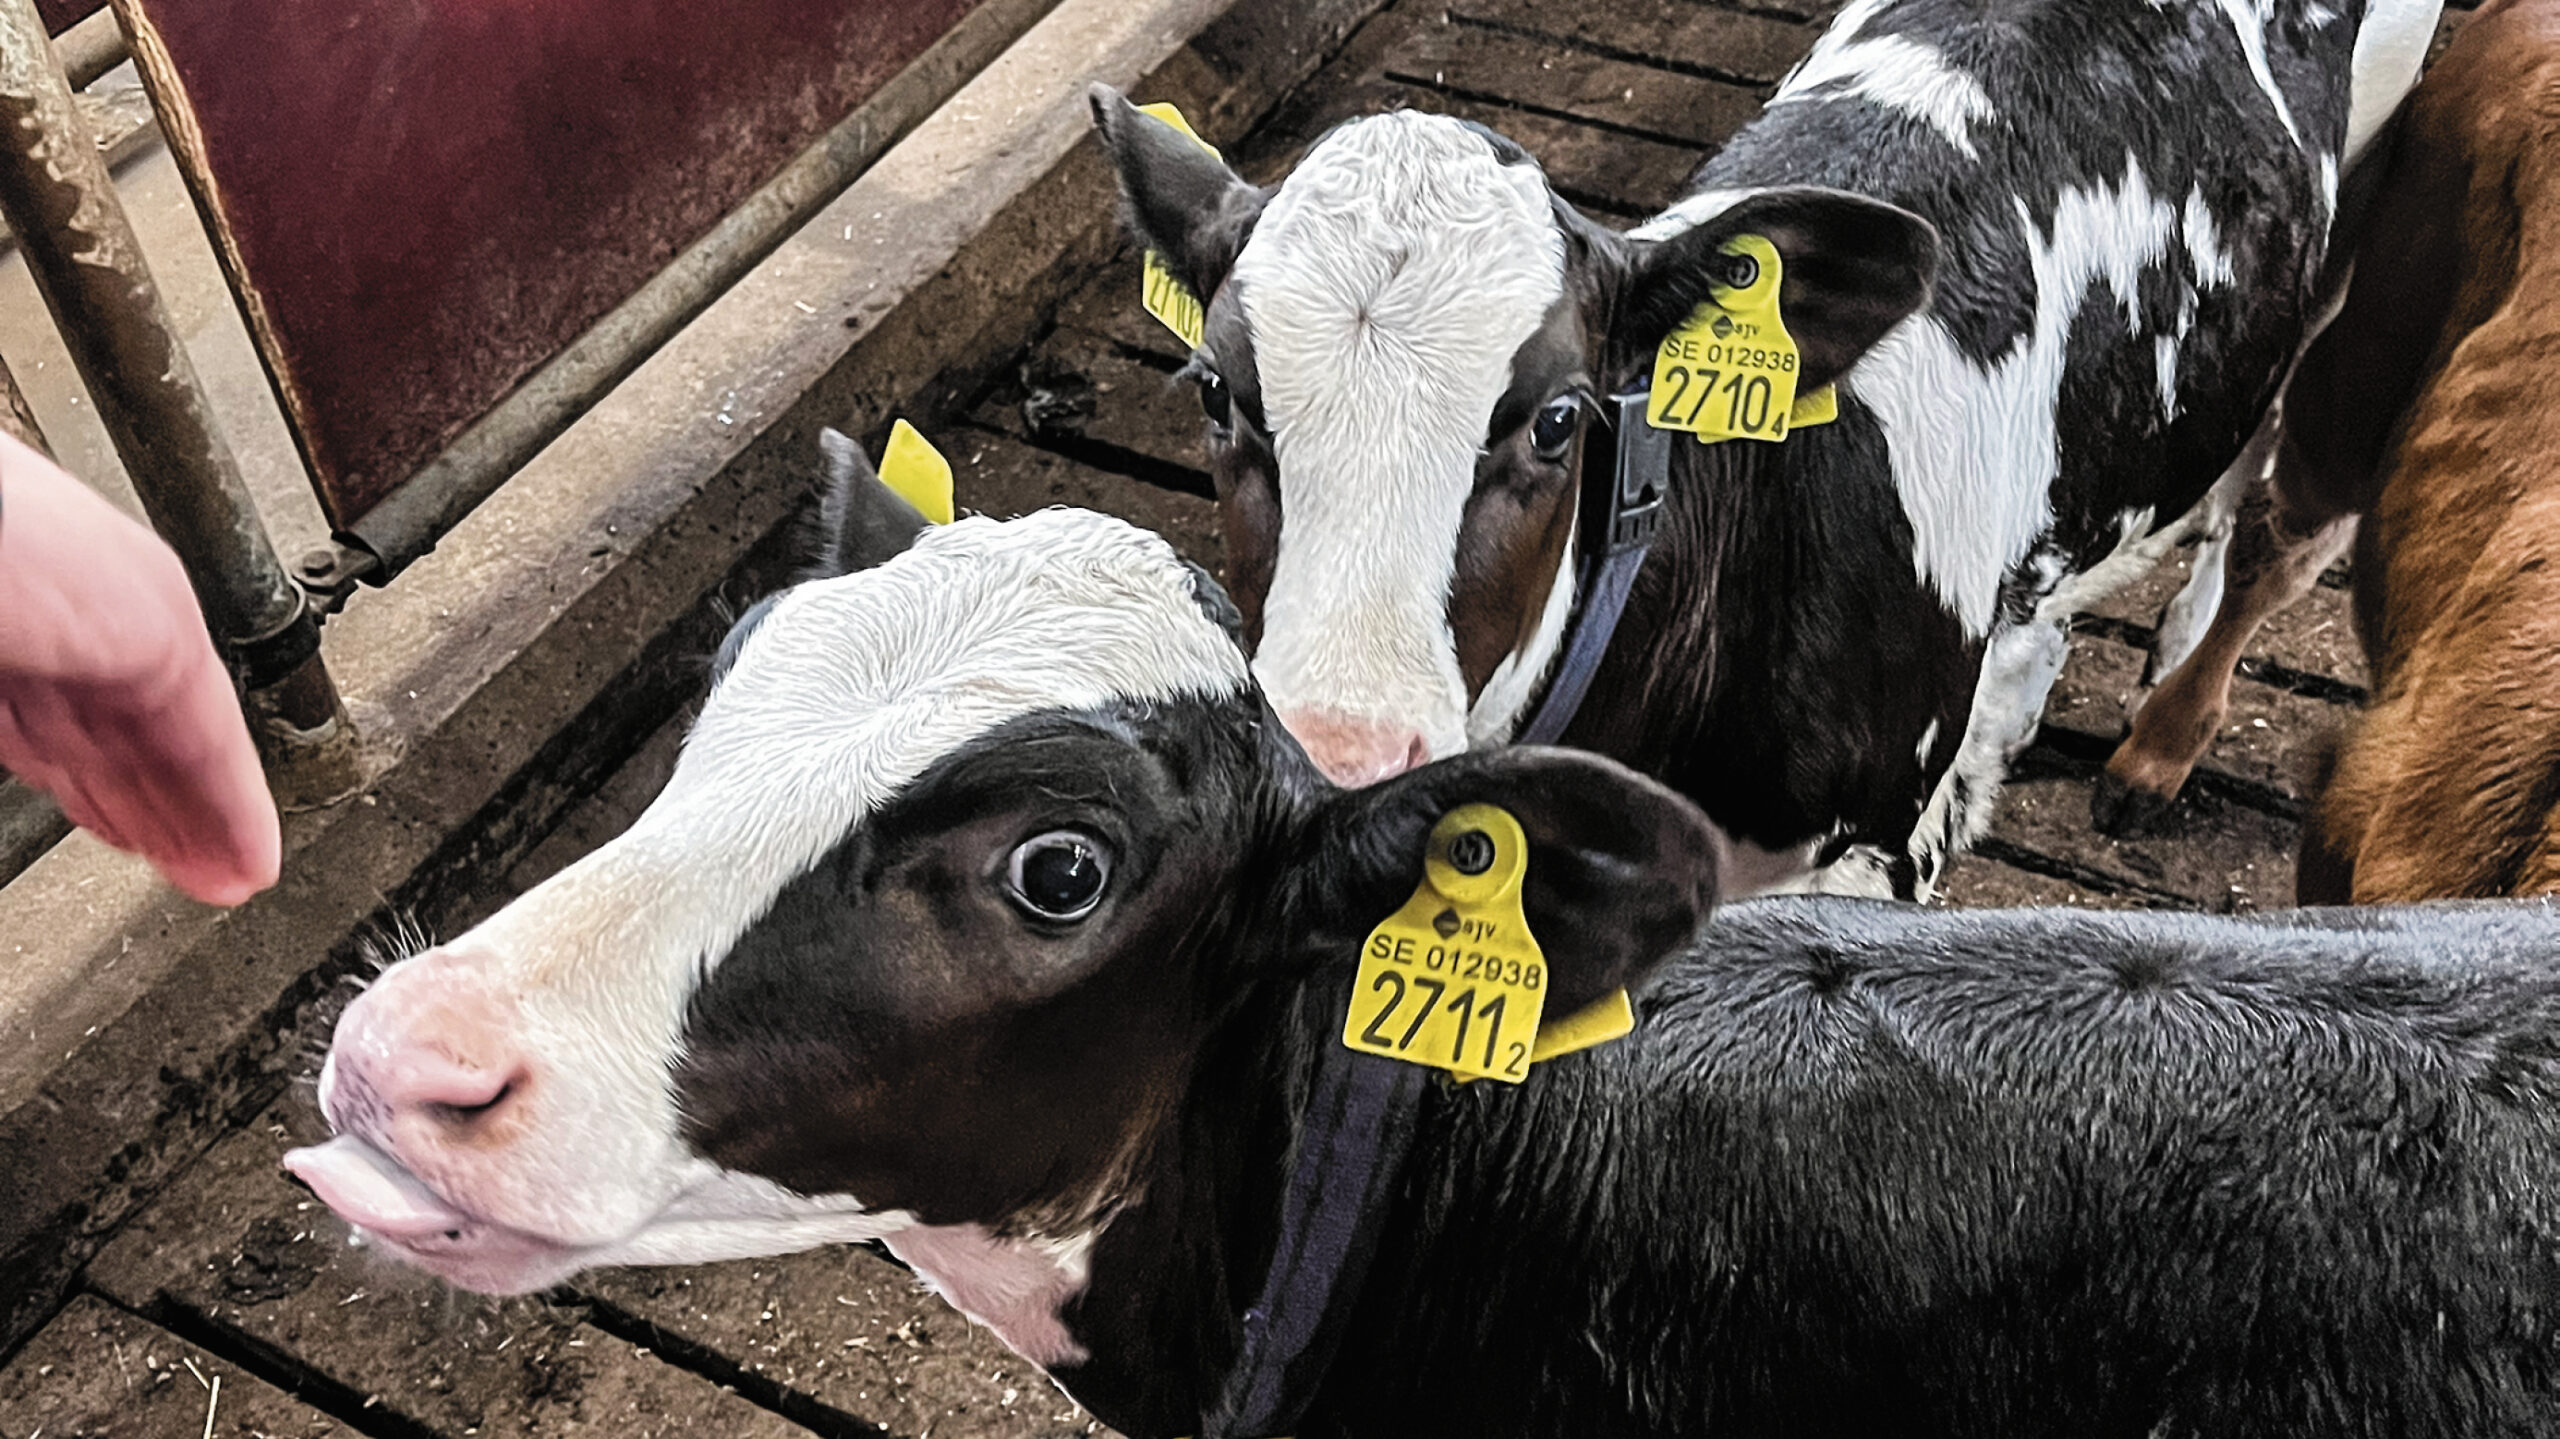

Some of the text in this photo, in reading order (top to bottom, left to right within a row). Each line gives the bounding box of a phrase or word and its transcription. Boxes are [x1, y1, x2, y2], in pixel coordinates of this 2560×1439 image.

[1664, 337, 1795, 373] SE 012938
[1370, 933, 1541, 990] SE 012938
